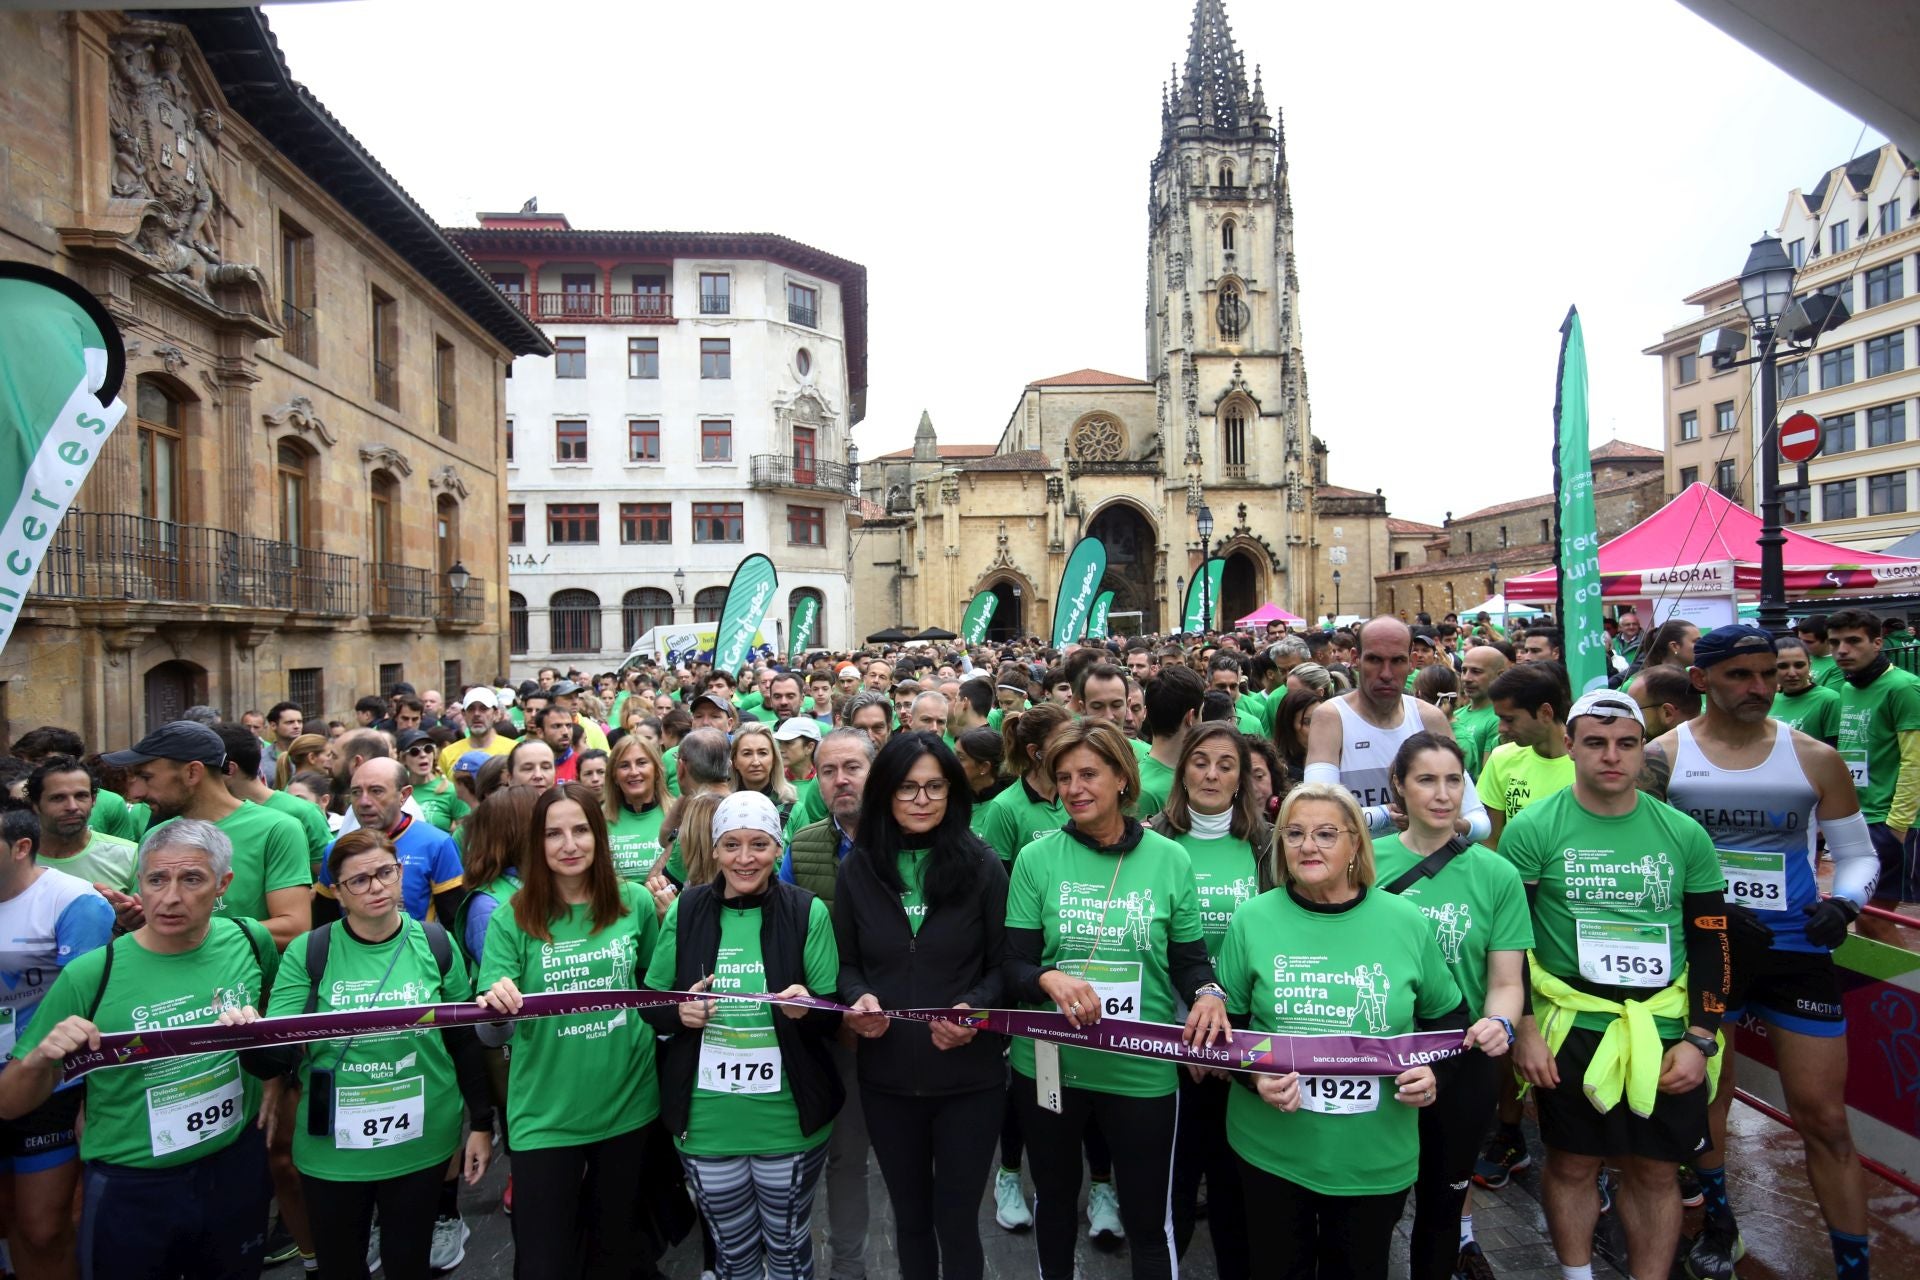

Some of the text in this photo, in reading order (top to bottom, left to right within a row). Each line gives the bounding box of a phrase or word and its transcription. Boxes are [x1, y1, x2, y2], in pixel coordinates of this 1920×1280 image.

[0, 412, 106, 614] ncer.es
[1650, 567, 1722, 584] LABORAL
[1878, 566, 1920, 579] LABOR
[1072, 562, 1097, 612] Inglés
[1564, 860, 1650, 874] En marcha
[1565, 875, 1617, 886] contra
[1060, 894, 1135, 909] En marcha
[1566, 888, 1642, 900] el cáncer
[1059, 908, 1104, 923] contra
[1200, 911, 1232, 921] ncer
[1060, 920, 1072, 934] el
[542, 946, 620, 968] En marcha
[1600, 954, 1664, 976] 1563
[544, 966, 590, 982] contra
[718, 960, 764, 974] march
[712, 976, 740, 988] ntra
[1274, 969, 1364, 986] En marcha
[331, 989, 410, 1006] En marcha
[1274, 985, 1328, 999] contra
[1101, 996, 1134, 1015] 64
[1274, 1000, 1355, 1018] el cáncer
[558, 1021, 606, 1037] LABORAL
[586, 1032, 606, 1040] kutxa
[1027, 1025, 1230, 1062] banca cooperativa LABORAL kutxa
[66, 1051, 105, 1072] utxa
[342, 1062, 394, 1072] LABORAL
[1336, 1056, 1378, 1064] cooperativa
[371, 1072, 394, 1080] kutxa
[717, 1062, 774, 1080] 1176
[1305, 1077, 1372, 1100] 1922
[187, 1098, 234, 1132] 898
[363, 1113, 410, 1136] 874
